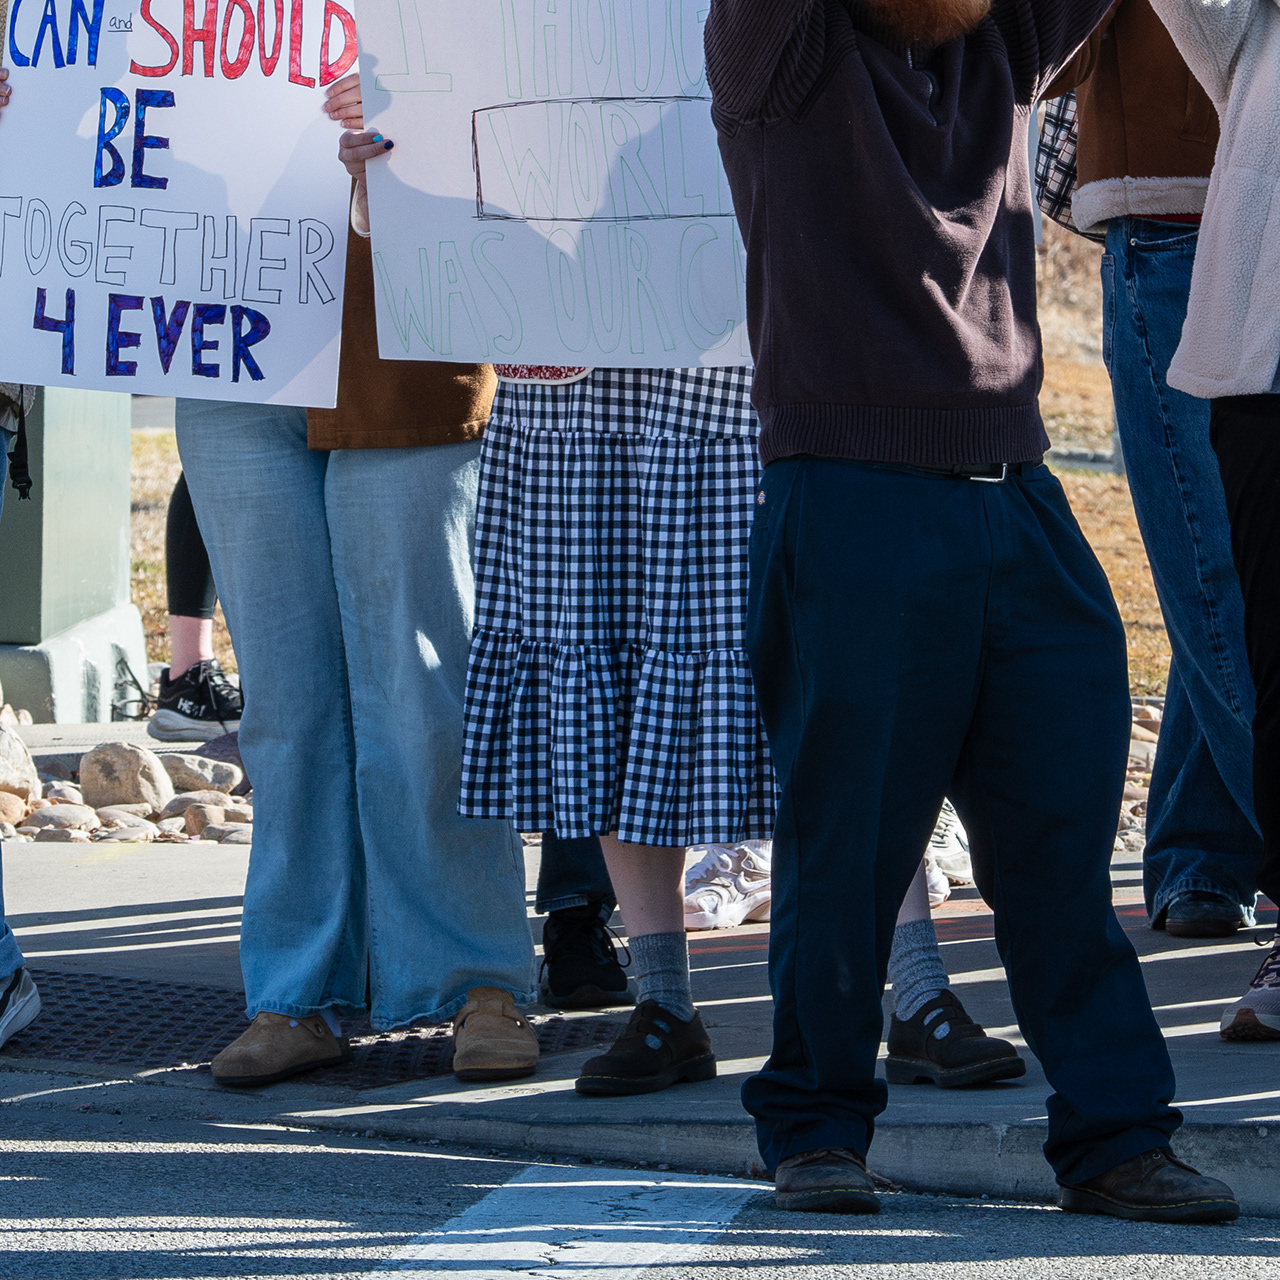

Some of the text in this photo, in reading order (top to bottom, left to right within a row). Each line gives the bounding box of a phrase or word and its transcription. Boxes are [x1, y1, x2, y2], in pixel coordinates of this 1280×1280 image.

[108, 13, 133, 32] and
[94, 87, 176, 190] BE
[487, 99, 726, 232] WORL
[33, 287, 272, 383] 4 EVER
[373, 230, 523, 357] WAS
[547, 225, 676, 354] OUR
